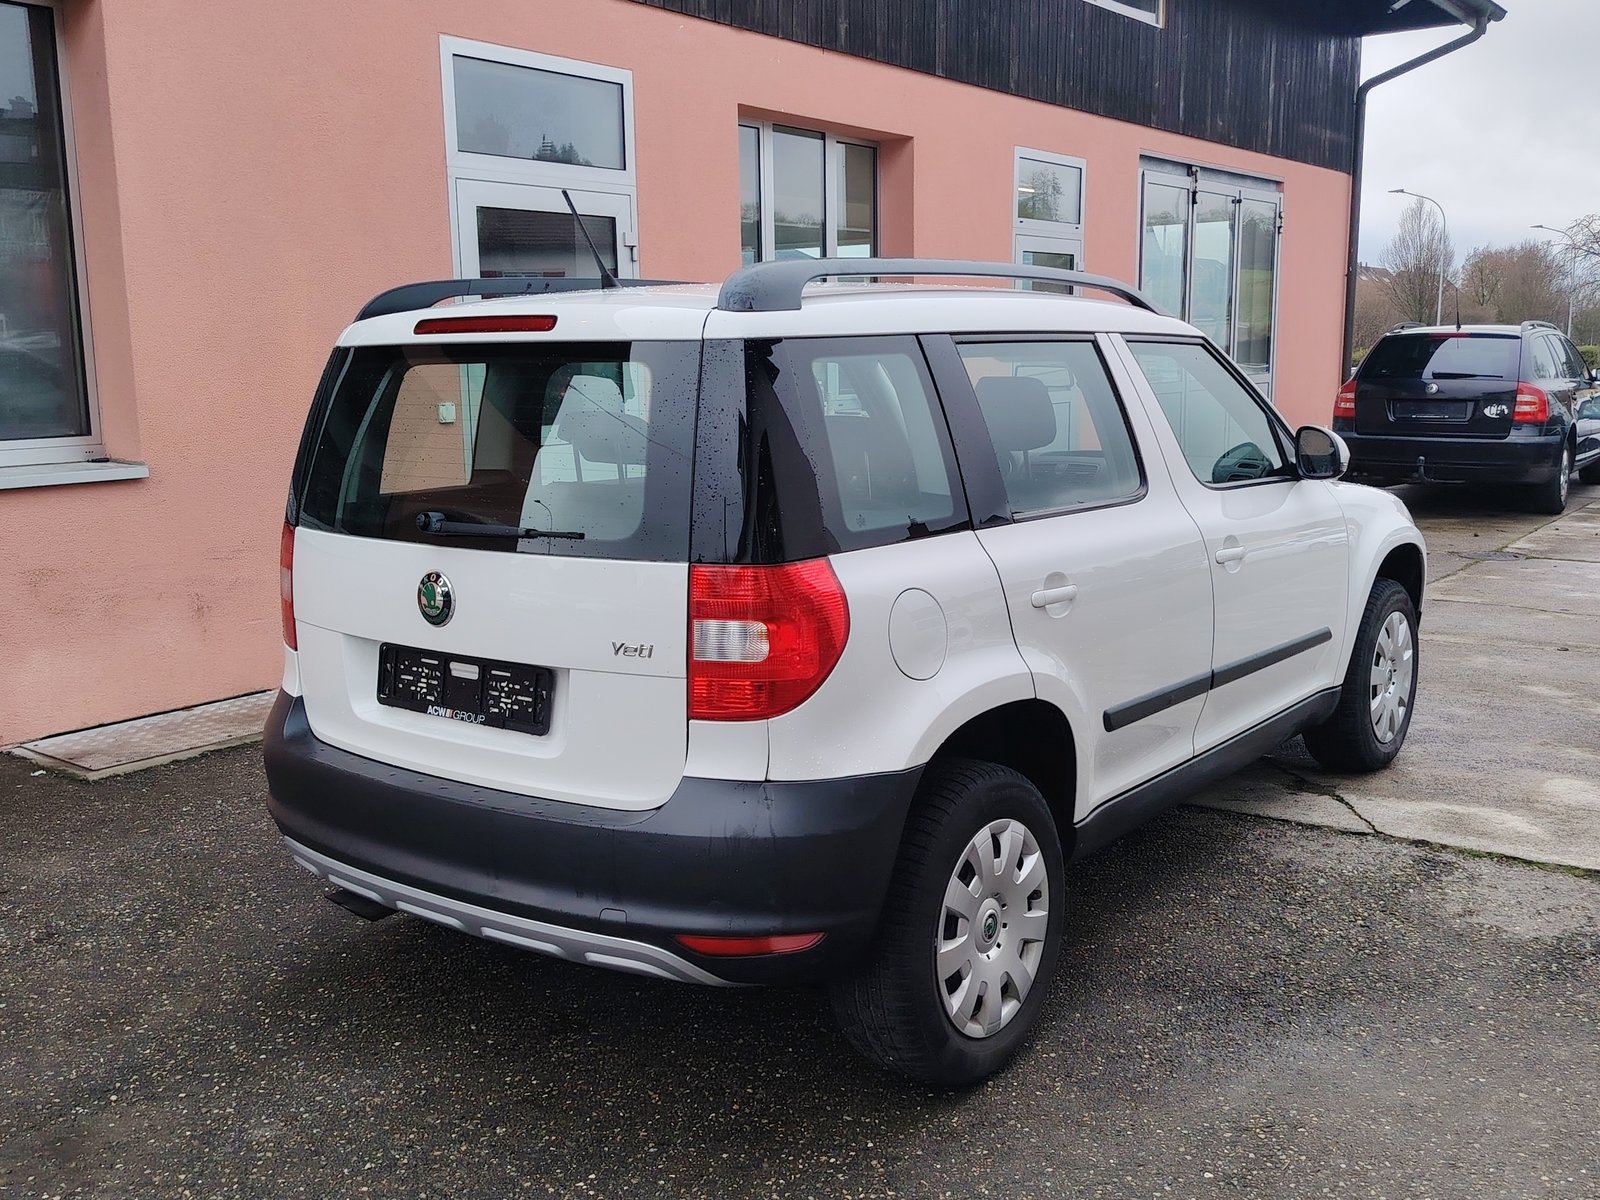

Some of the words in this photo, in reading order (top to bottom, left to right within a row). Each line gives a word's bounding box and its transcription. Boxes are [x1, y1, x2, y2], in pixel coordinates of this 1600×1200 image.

[612, 641, 653, 659] Yeti
[427, 705, 446, 717] ACW
[453, 710, 485, 723] GROUP
